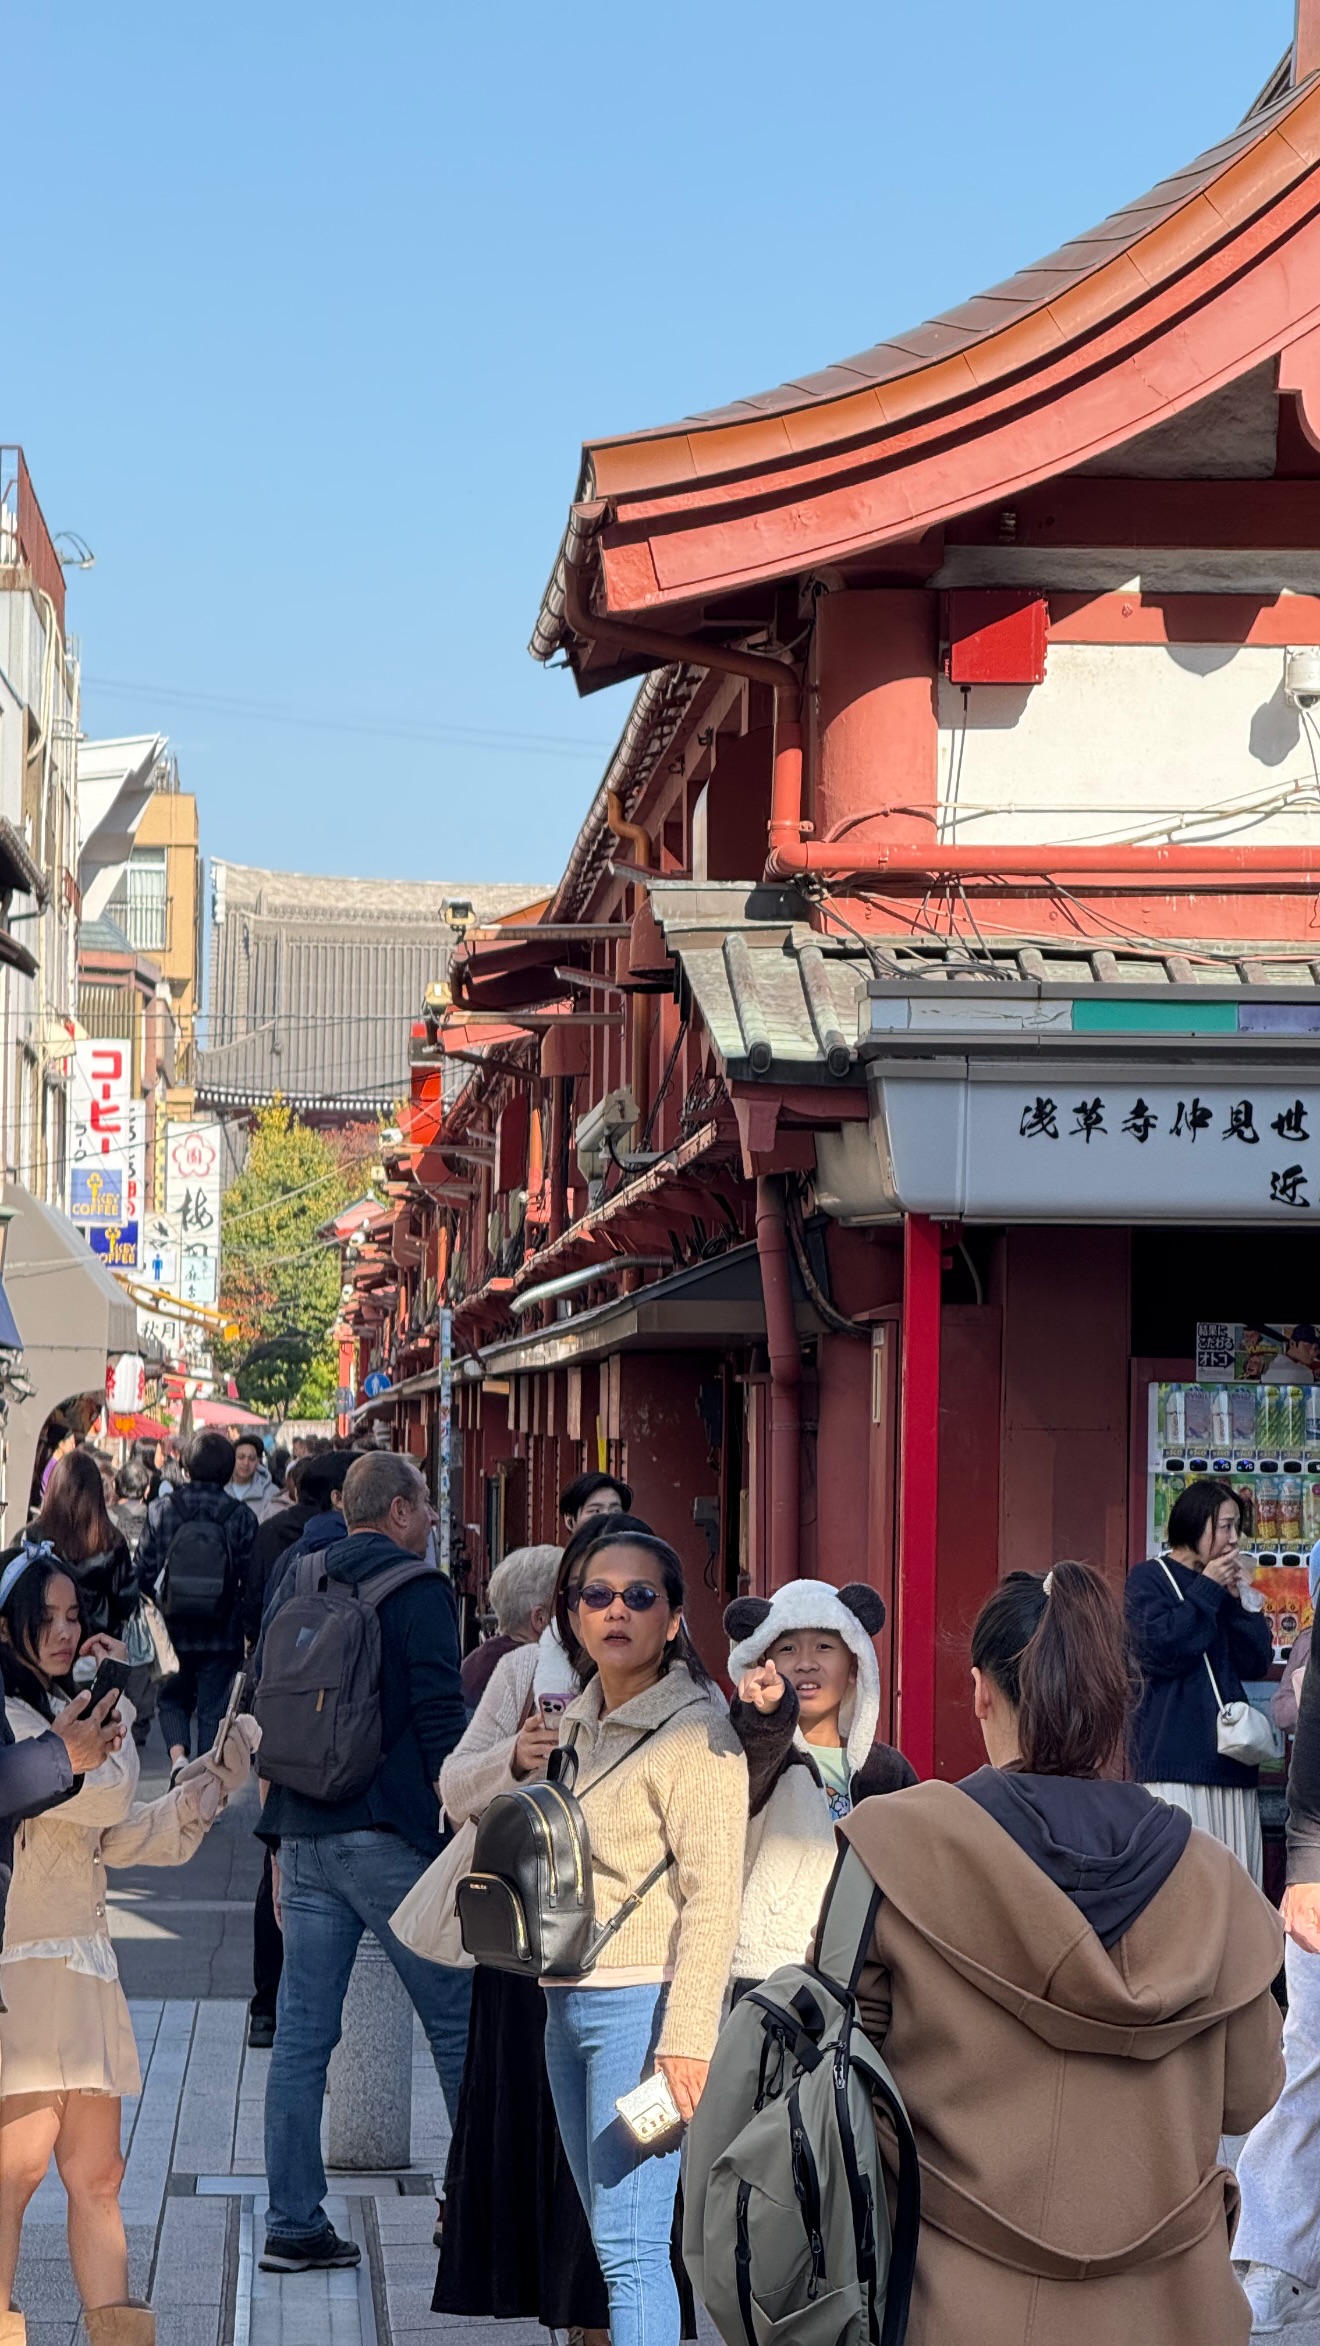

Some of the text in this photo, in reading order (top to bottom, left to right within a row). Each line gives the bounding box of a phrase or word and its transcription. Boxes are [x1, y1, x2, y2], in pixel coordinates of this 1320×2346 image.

[90, 1050, 122, 1154] コーヒー
[1019, 1096, 1310, 1144] 浅草寺仲見世
[97, 1193, 120, 1205] KEY
[72, 1202, 119, 1216] COFFEE
[115, 1242, 136, 1254] KEY
[97, 1252, 136, 1265] OFFEE
[1199, 1324, 1227, 1336] 結果に
[1199, 1337, 1233, 1350] こだわる
[1199, 1352, 1228, 1366] オトコ
